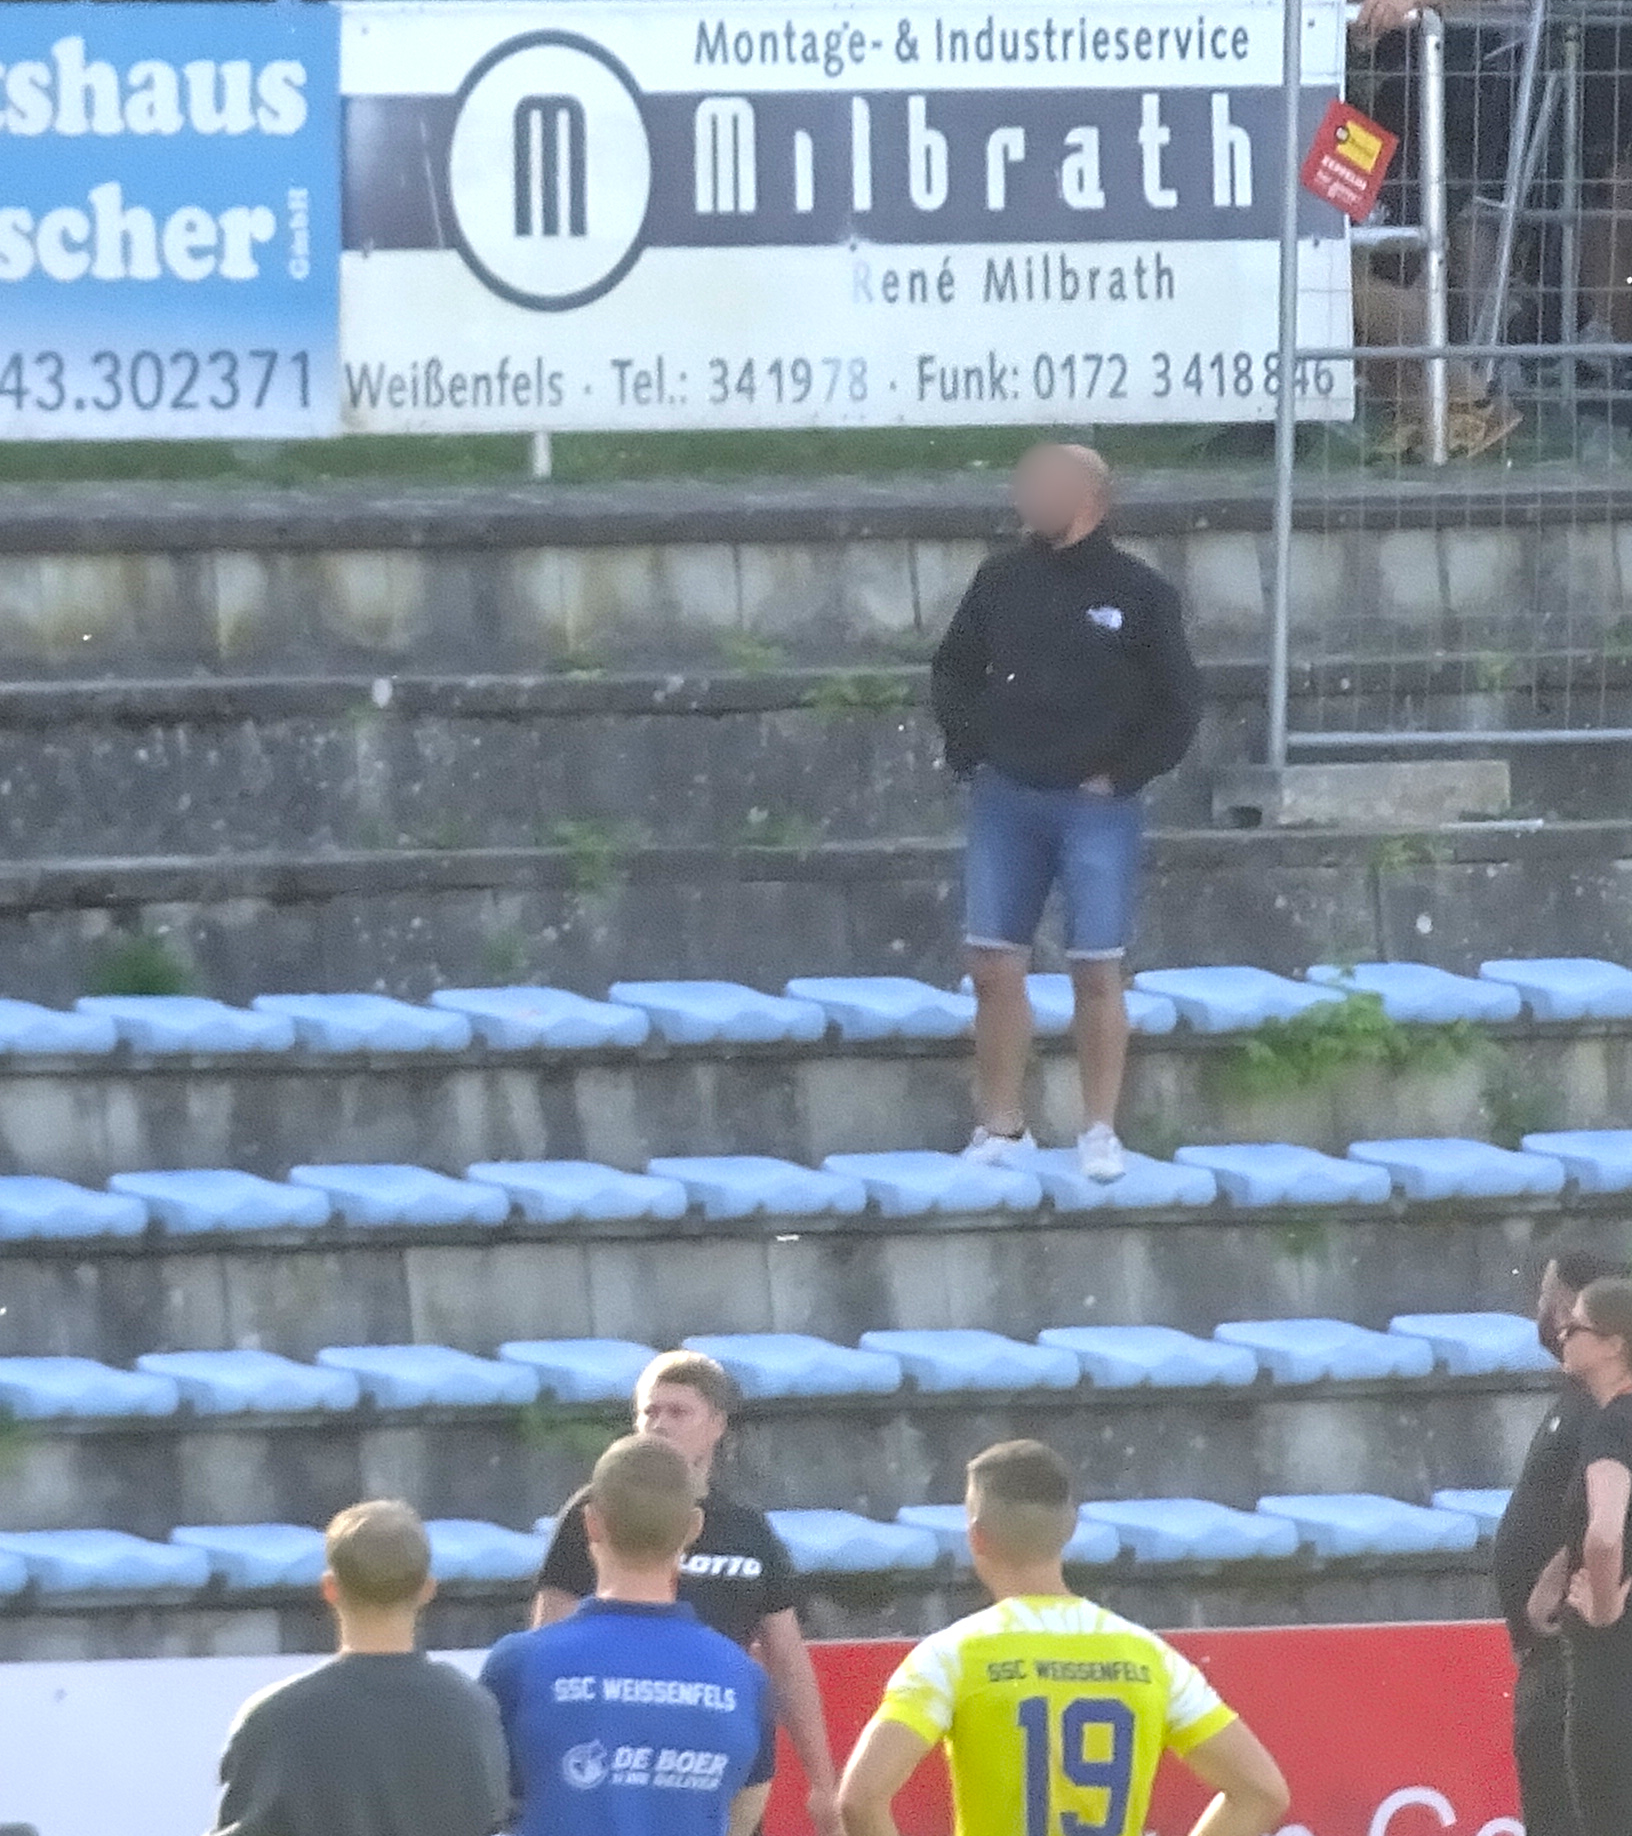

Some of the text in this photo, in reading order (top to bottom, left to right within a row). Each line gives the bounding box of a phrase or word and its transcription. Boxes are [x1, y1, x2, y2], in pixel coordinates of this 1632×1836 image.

[693, 15, 1249, 78] Montage- & Industrieservice
[694, 92, 1252, 214] Milbrath
[288, 188, 310, 280] GmbH
[852, 254, 1176, 303] René Milbrath
[345, 355, 564, 408] Weißenfels
[610, 354, 687, 406] Tel.:
[707, 356, 869, 404] 341978
[917, 348, 1019, 402] Funk:
[1033, 351, 1128, 400] 0172
[552, 1676, 736, 1713] SSC WEISSENFELS
[988, 1660, 1151, 1683] SSC WEISSENFELS
[612, 1745, 729, 1773] DE BOER
[1017, 1696, 1136, 1836] 19
